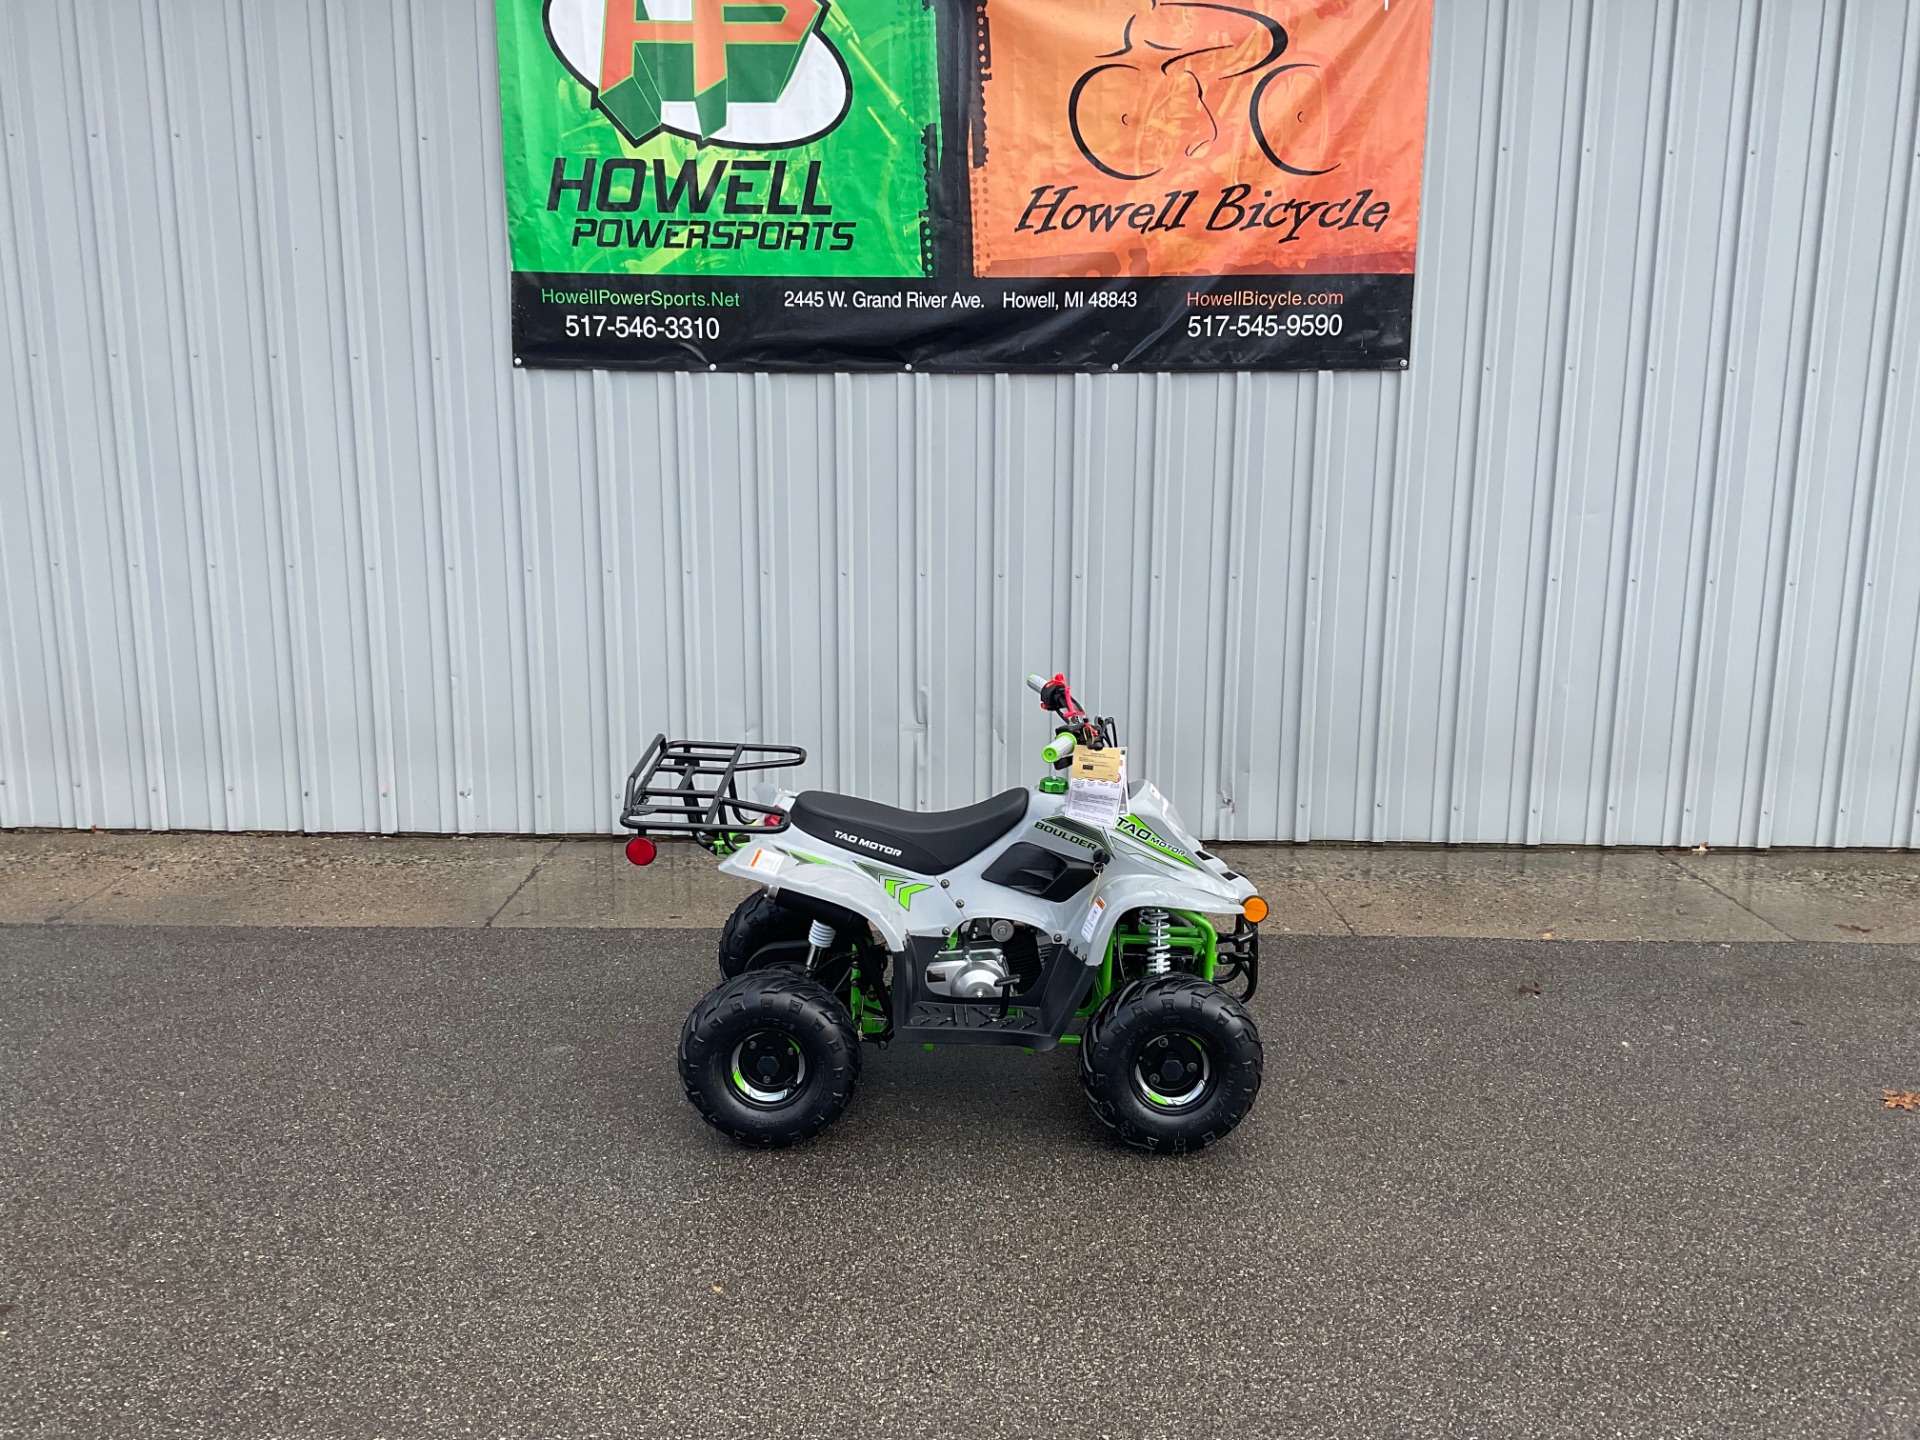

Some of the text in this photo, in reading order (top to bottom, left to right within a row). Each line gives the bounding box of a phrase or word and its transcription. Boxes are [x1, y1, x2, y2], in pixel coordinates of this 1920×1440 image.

[546, 157, 833, 215] HOWELL
[1014, 183, 1391, 243] Howell Bicycle
[571, 218, 857, 251] POWERSPORTS
[541, 288, 740, 309] HowellPowerSports.Net
[784, 291, 1138, 310] 2445 W. Grand River Ave. Howell, MI 48843
[1186, 291, 1344, 310] HowellBicycle.com
[565, 315, 720, 340] 517-546-3310
[1187, 313, 1343, 338] 517-545-9590
[834, 830, 902, 857] TAO MOTOR
[1034, 821, 1098, 851] BOULDER
[1116, 817, 1186, 856] TAO MOTOR
